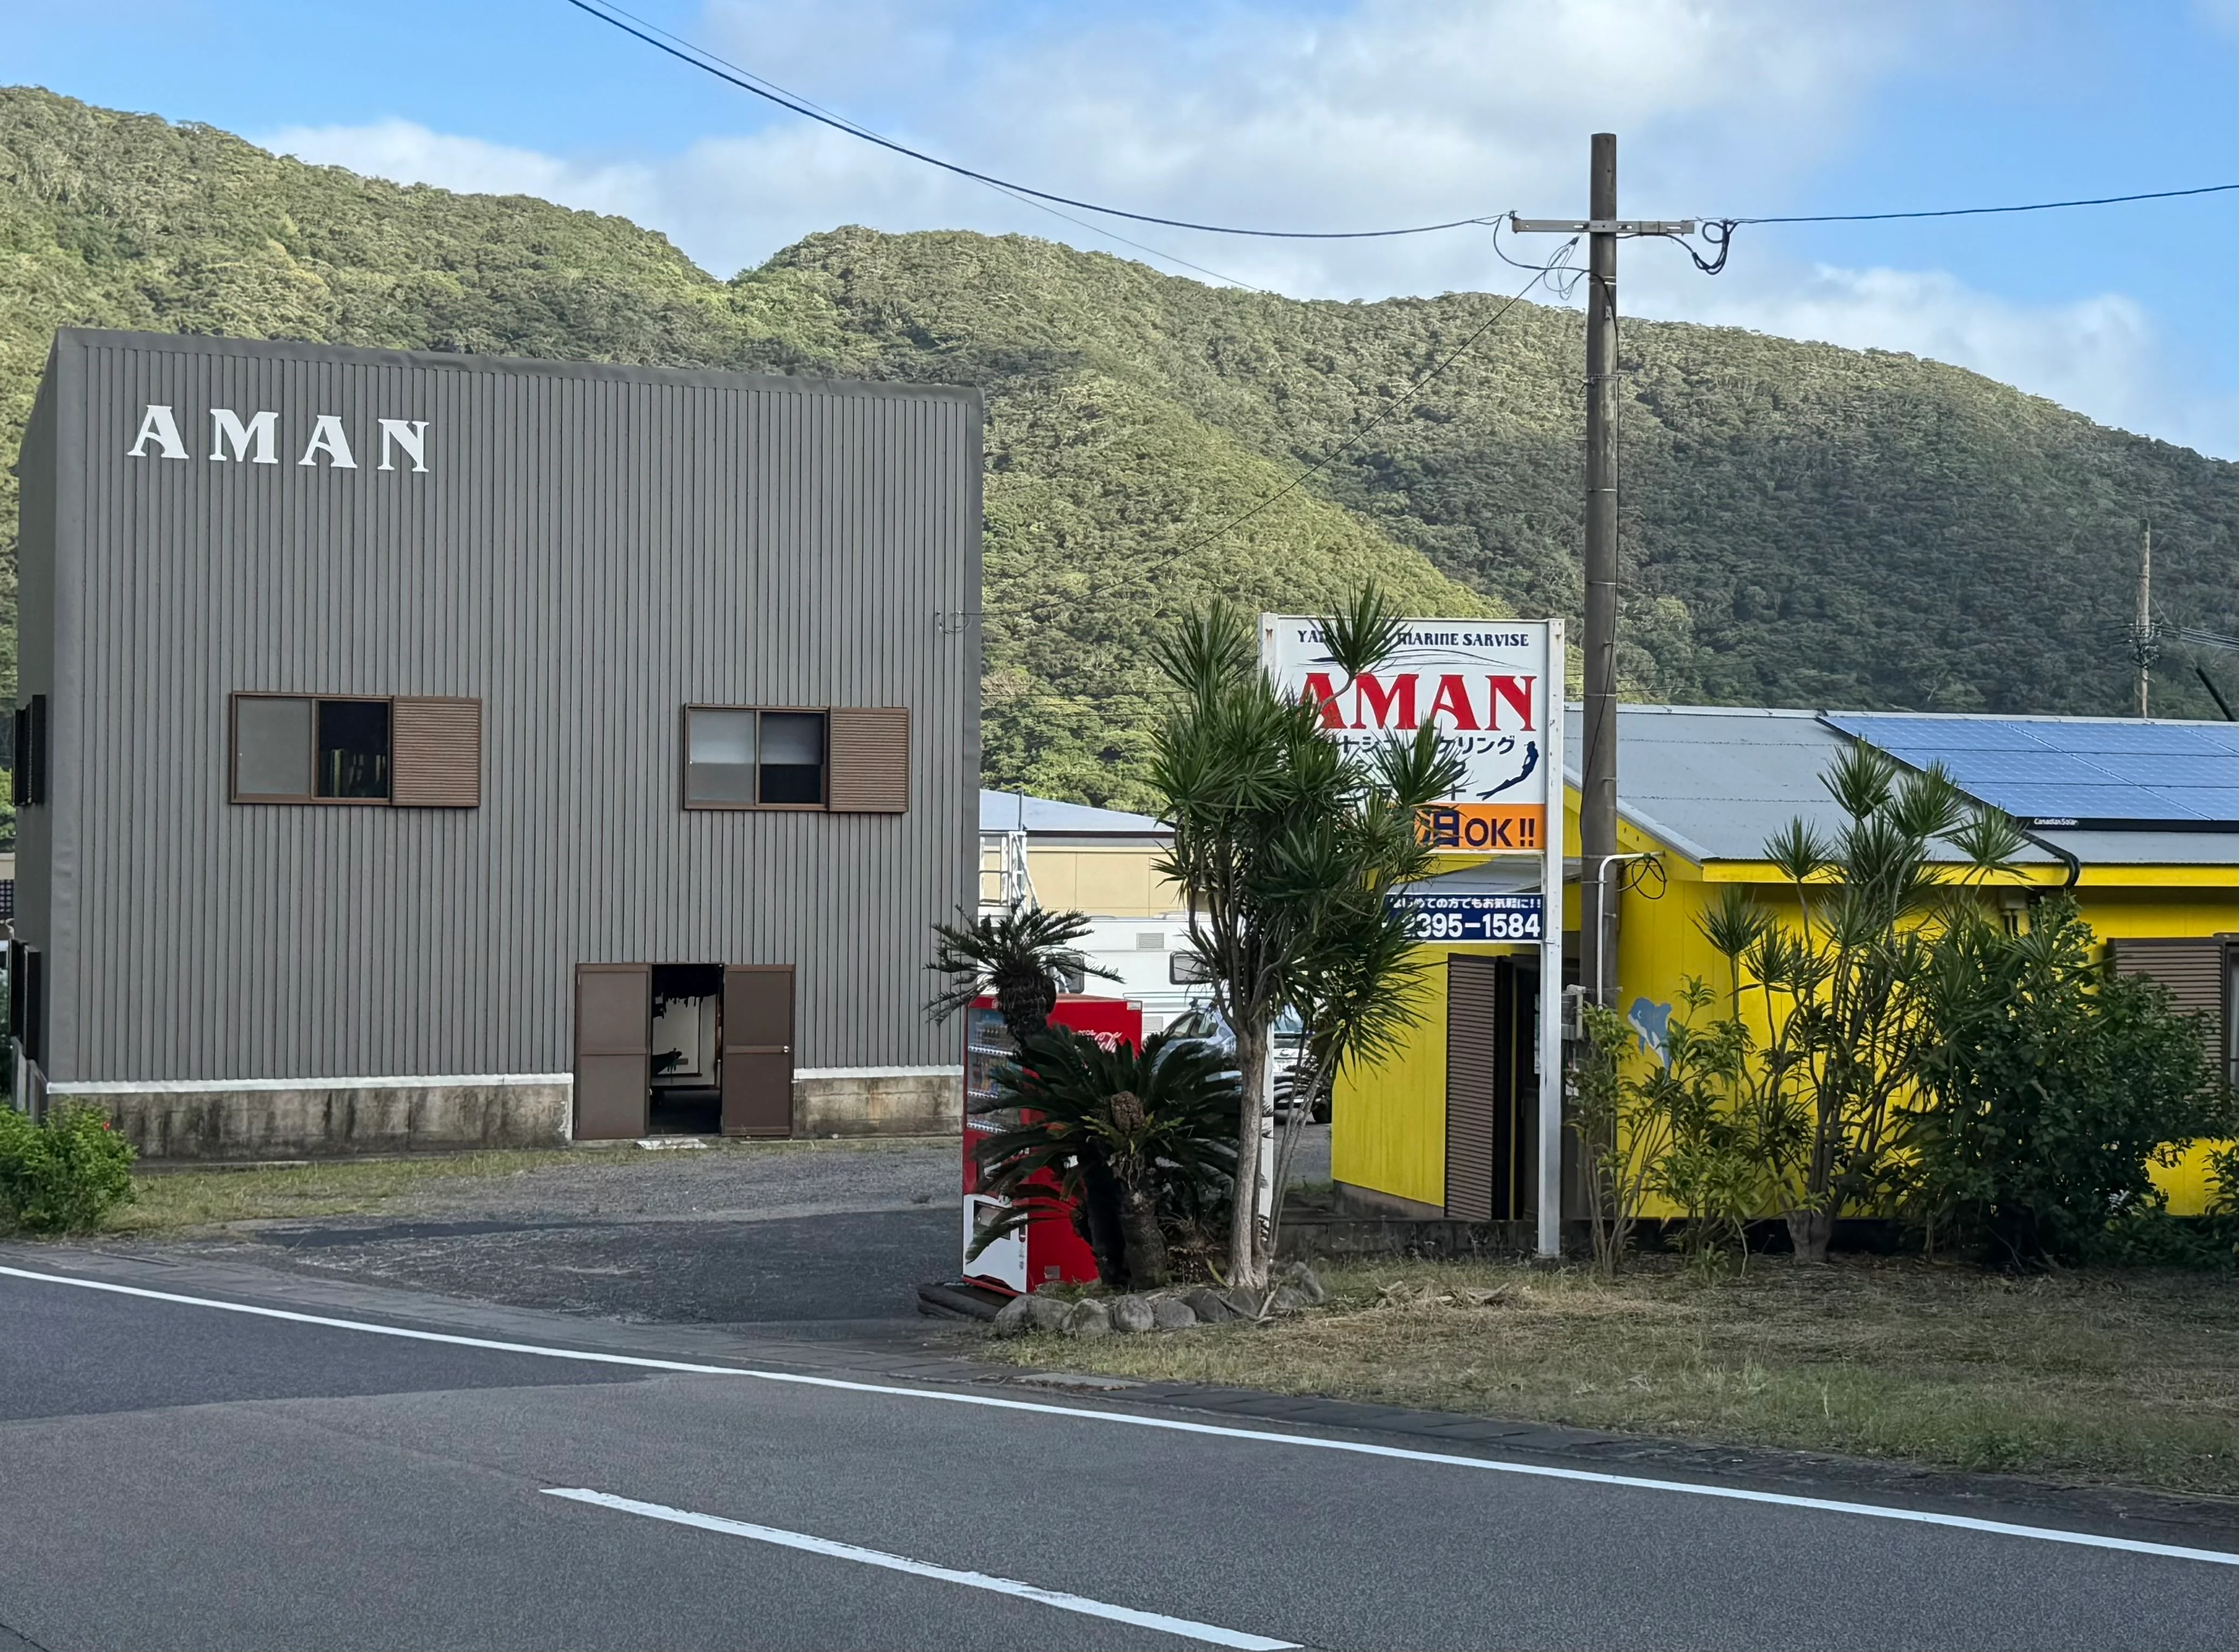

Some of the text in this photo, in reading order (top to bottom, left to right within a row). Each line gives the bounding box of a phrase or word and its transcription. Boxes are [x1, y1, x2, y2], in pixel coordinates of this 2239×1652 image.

[127, 404, 430, 473] AMAN
[1462, 633, 1529, 646] SARVISE
[1299, 672, 1537, 731] AMAN
